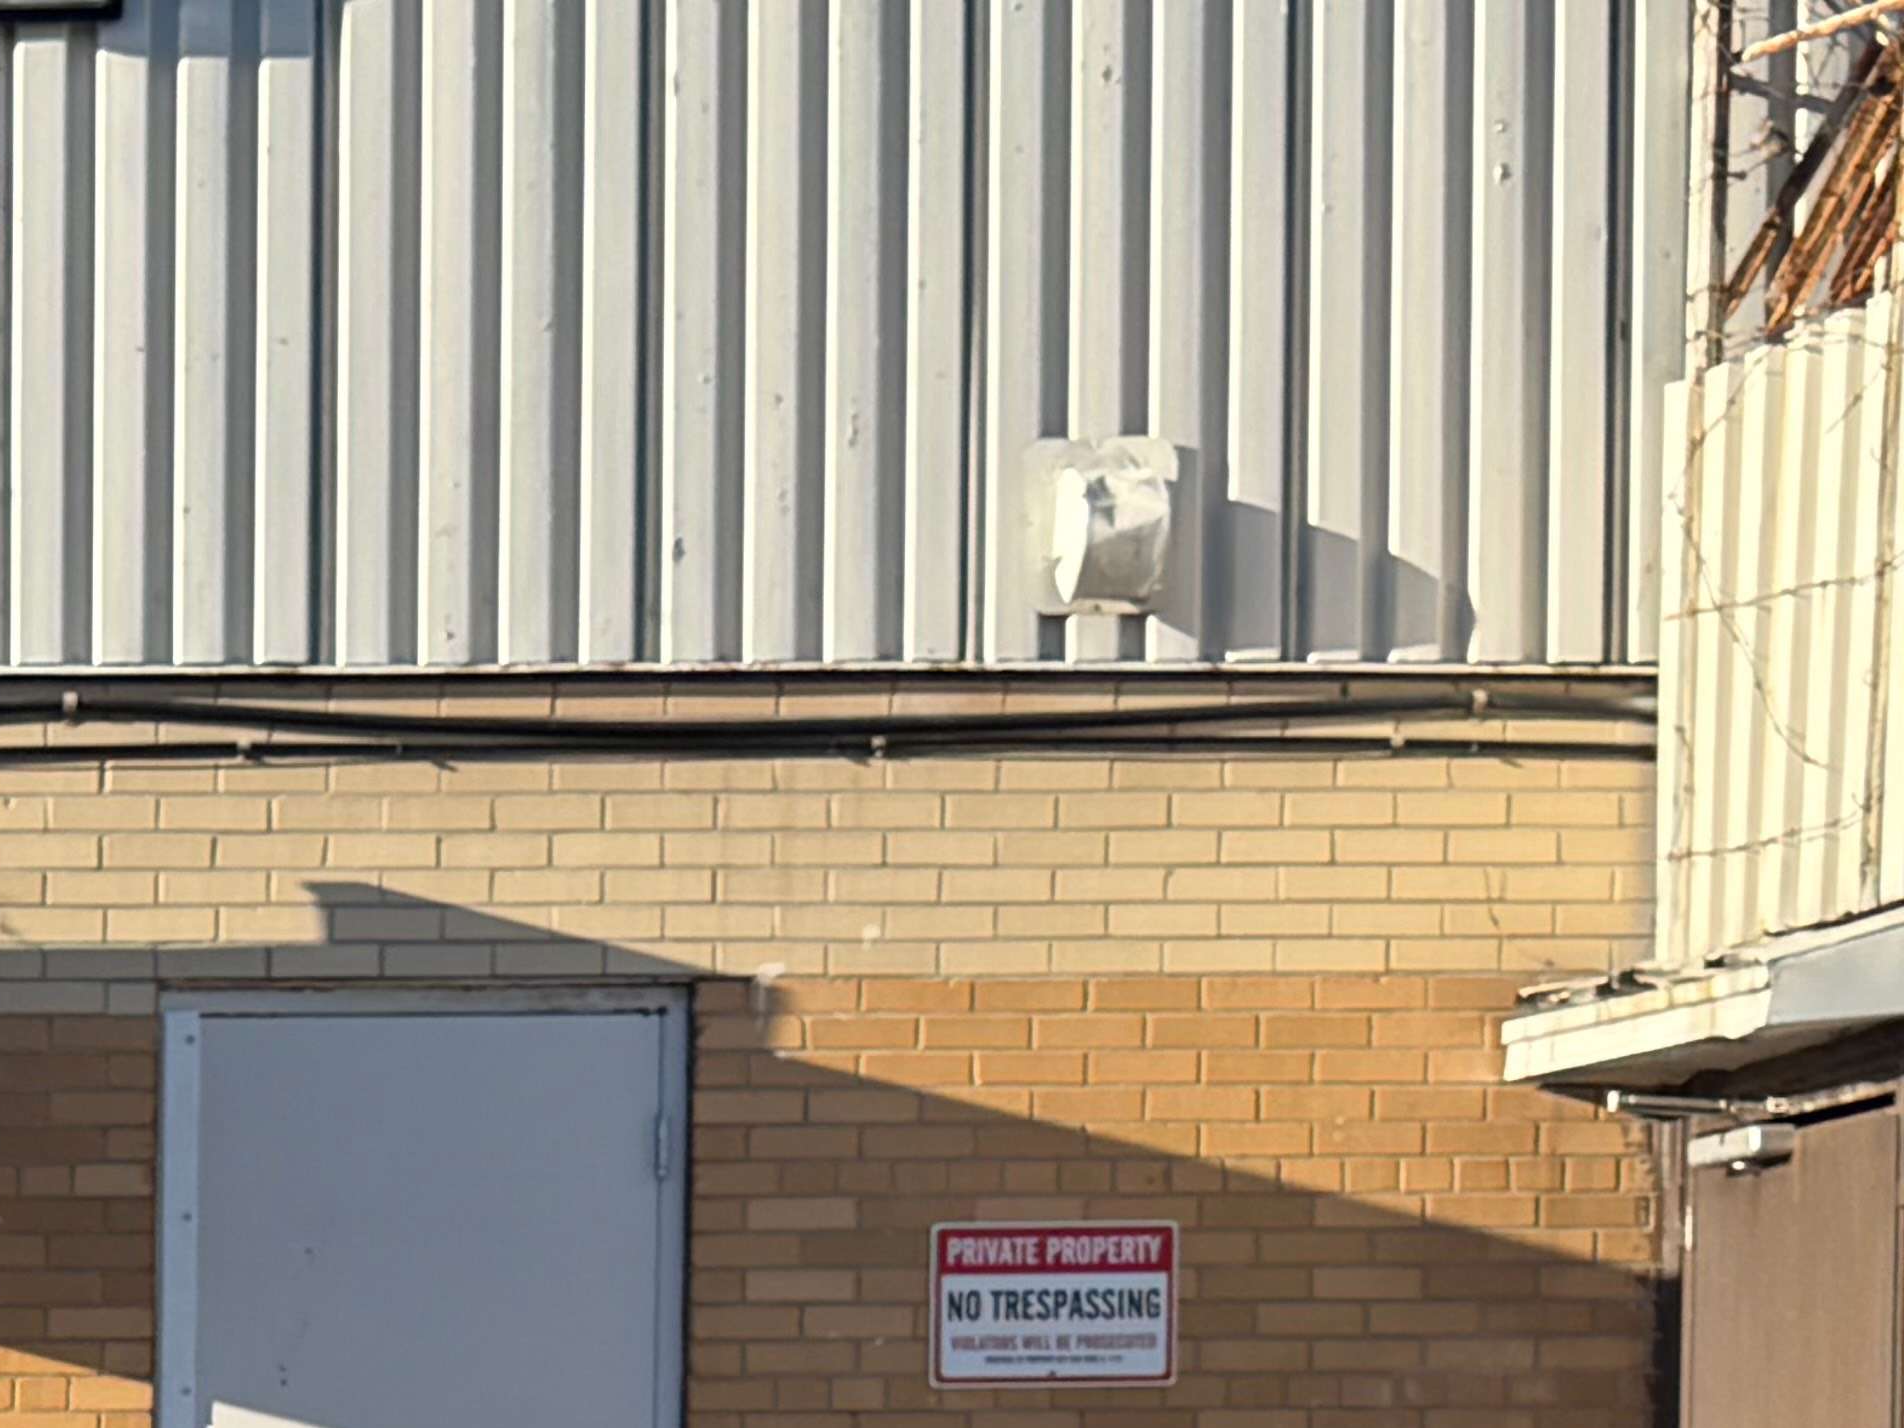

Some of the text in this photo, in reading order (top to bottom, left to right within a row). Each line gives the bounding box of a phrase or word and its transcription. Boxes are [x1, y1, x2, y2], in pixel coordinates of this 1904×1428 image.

[946, 1234, 1163, 1266] PRIVATE PROPERTY
[947, 1287, 1161, 1322] NO TRESPASSING
